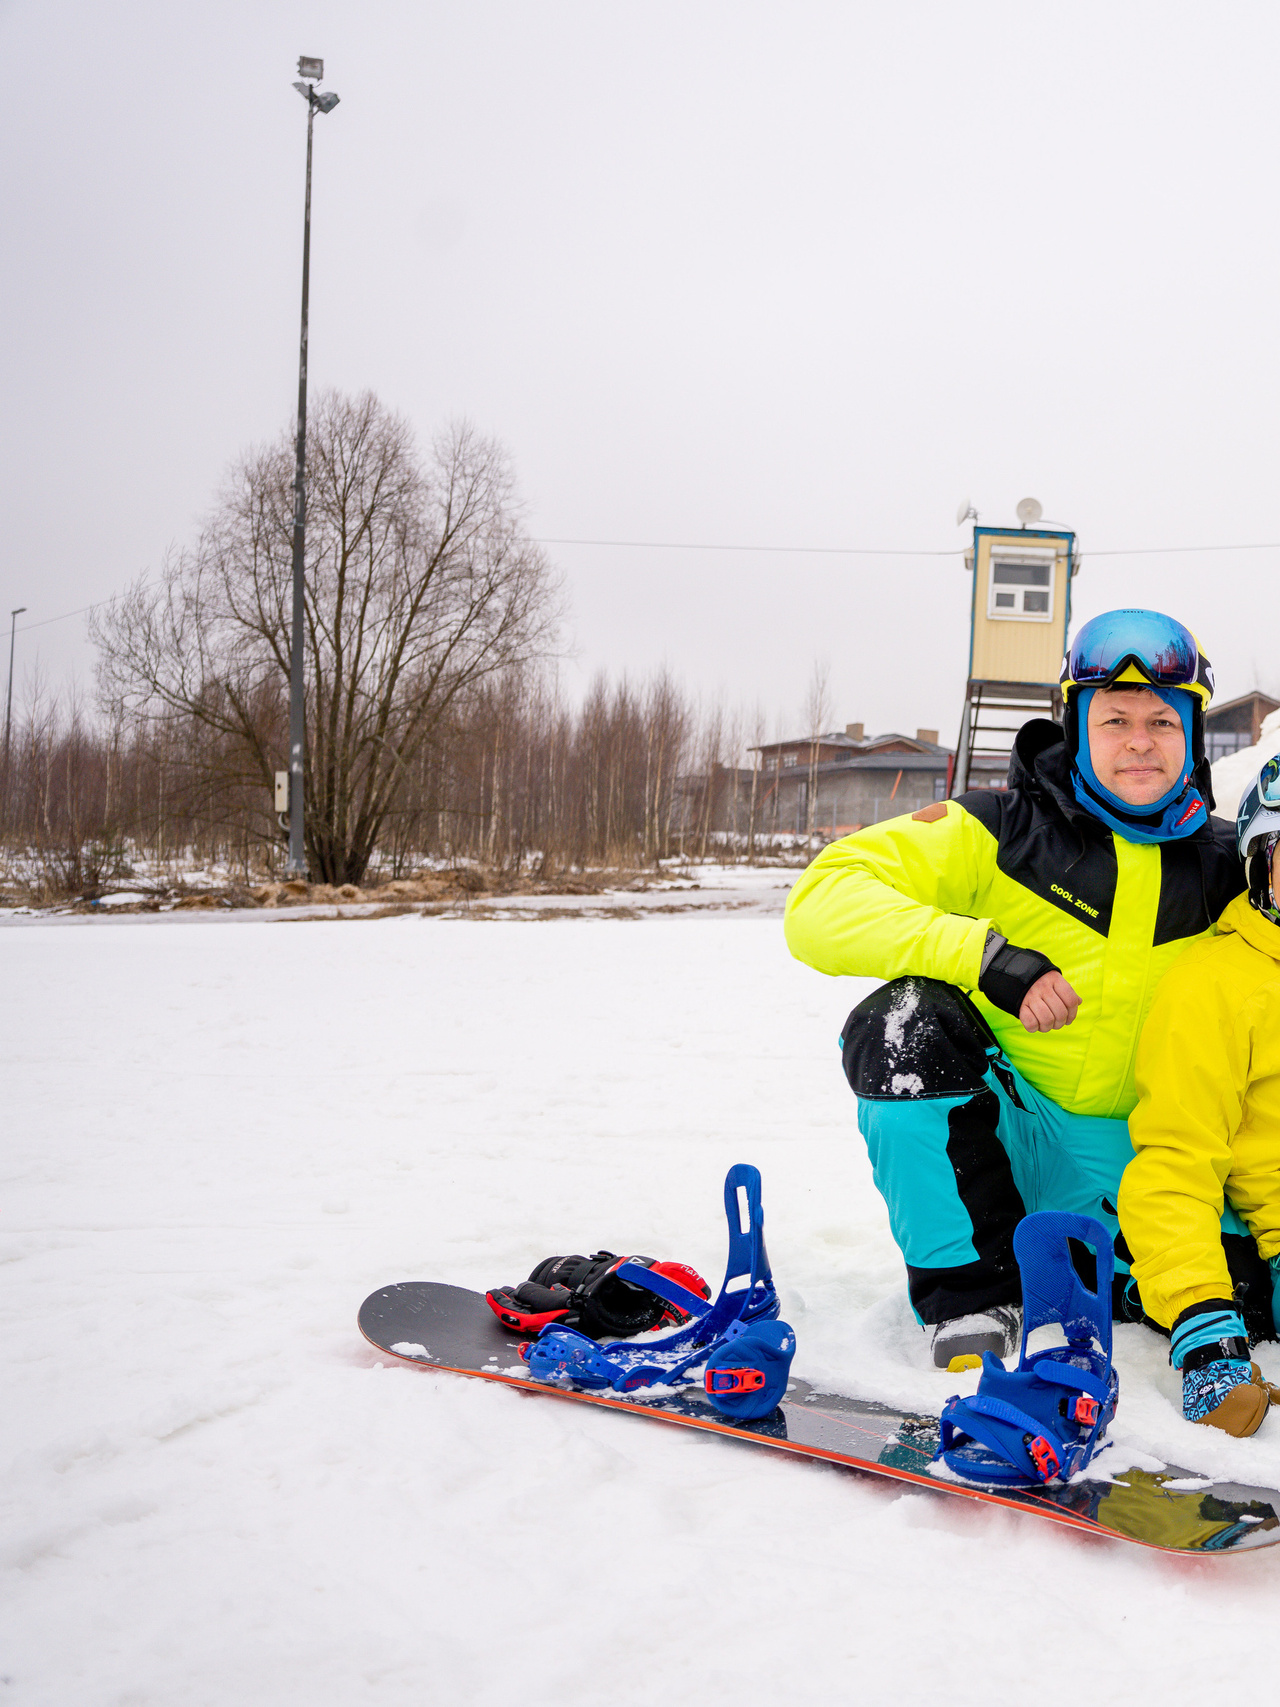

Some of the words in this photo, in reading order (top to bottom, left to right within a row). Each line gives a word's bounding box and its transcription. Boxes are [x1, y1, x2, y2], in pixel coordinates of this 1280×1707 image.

[1050, 884, 1073, 903] COOL
[1074, 899, 1099, 918] ZONE
[680, 1264, 703, 1281] MATT
